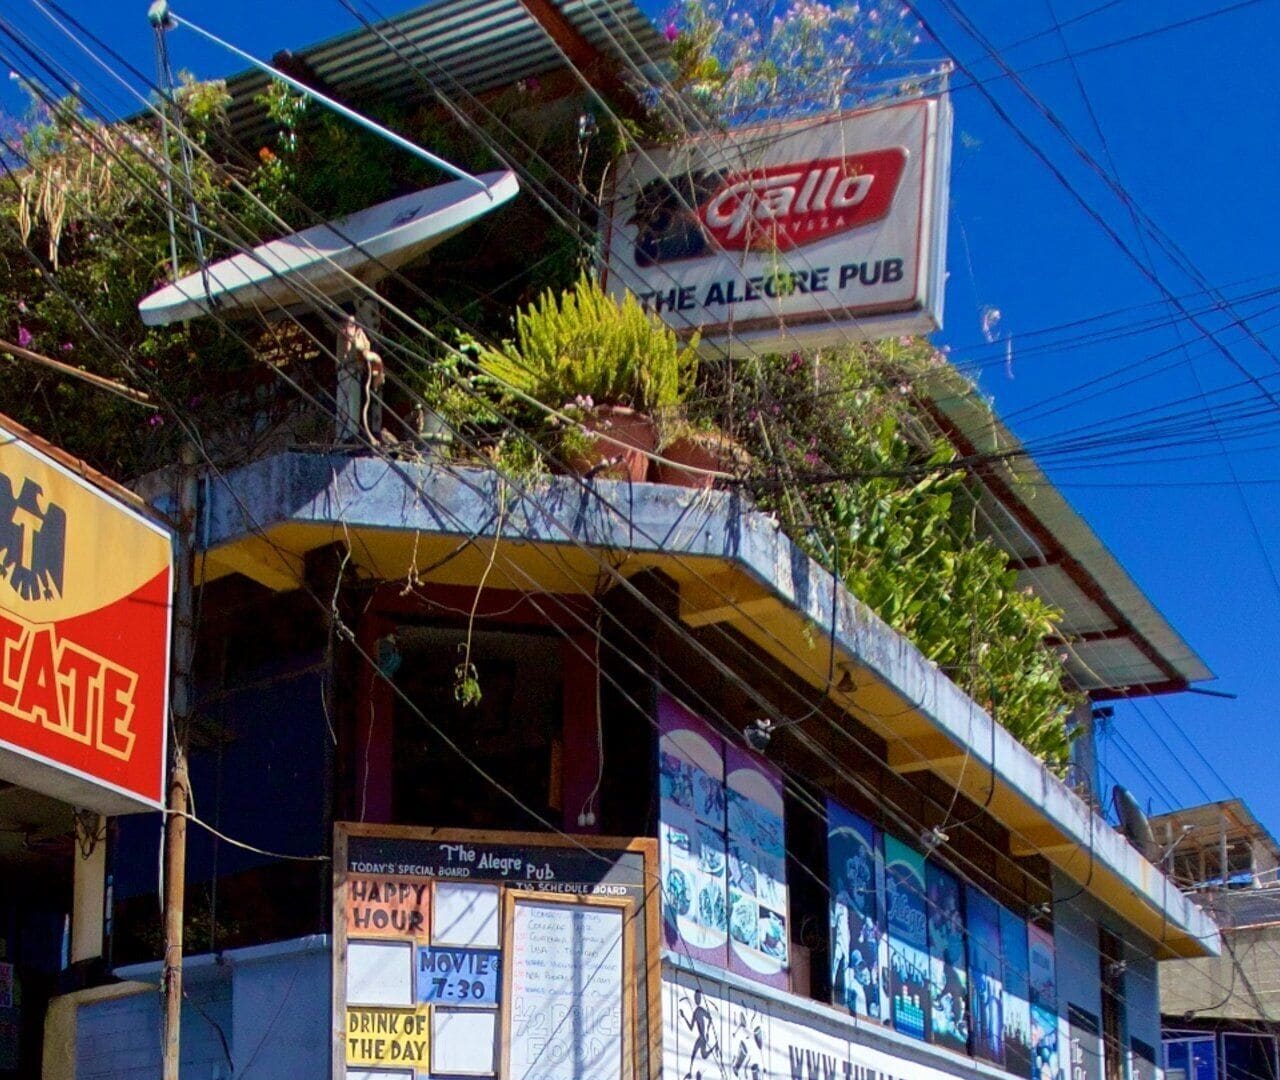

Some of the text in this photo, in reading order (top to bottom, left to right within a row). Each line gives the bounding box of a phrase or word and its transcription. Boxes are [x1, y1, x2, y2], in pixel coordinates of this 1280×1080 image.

[706, 165, 874, 240] Gallo
[838, 258, 904, 288] PUB
[351, 862, 470, 877] TODAY'S SPECIAL BOARD
[440, 845, 554, 880] The Alegre Pub
[352, 880, 428, 905] HAPPY
[538, 882, 588, 894] SCHEDULE
[592, 885, 627, 895] BOARD
[353, 907, 425, 933] HOUR
[420, 950, 489, 976] MOVIE
[432, 978, 485, 999] 7:30
[349, 1012, 427, 1034] DRINK OF
[349, 1038, 428, 1061] THE DAY
